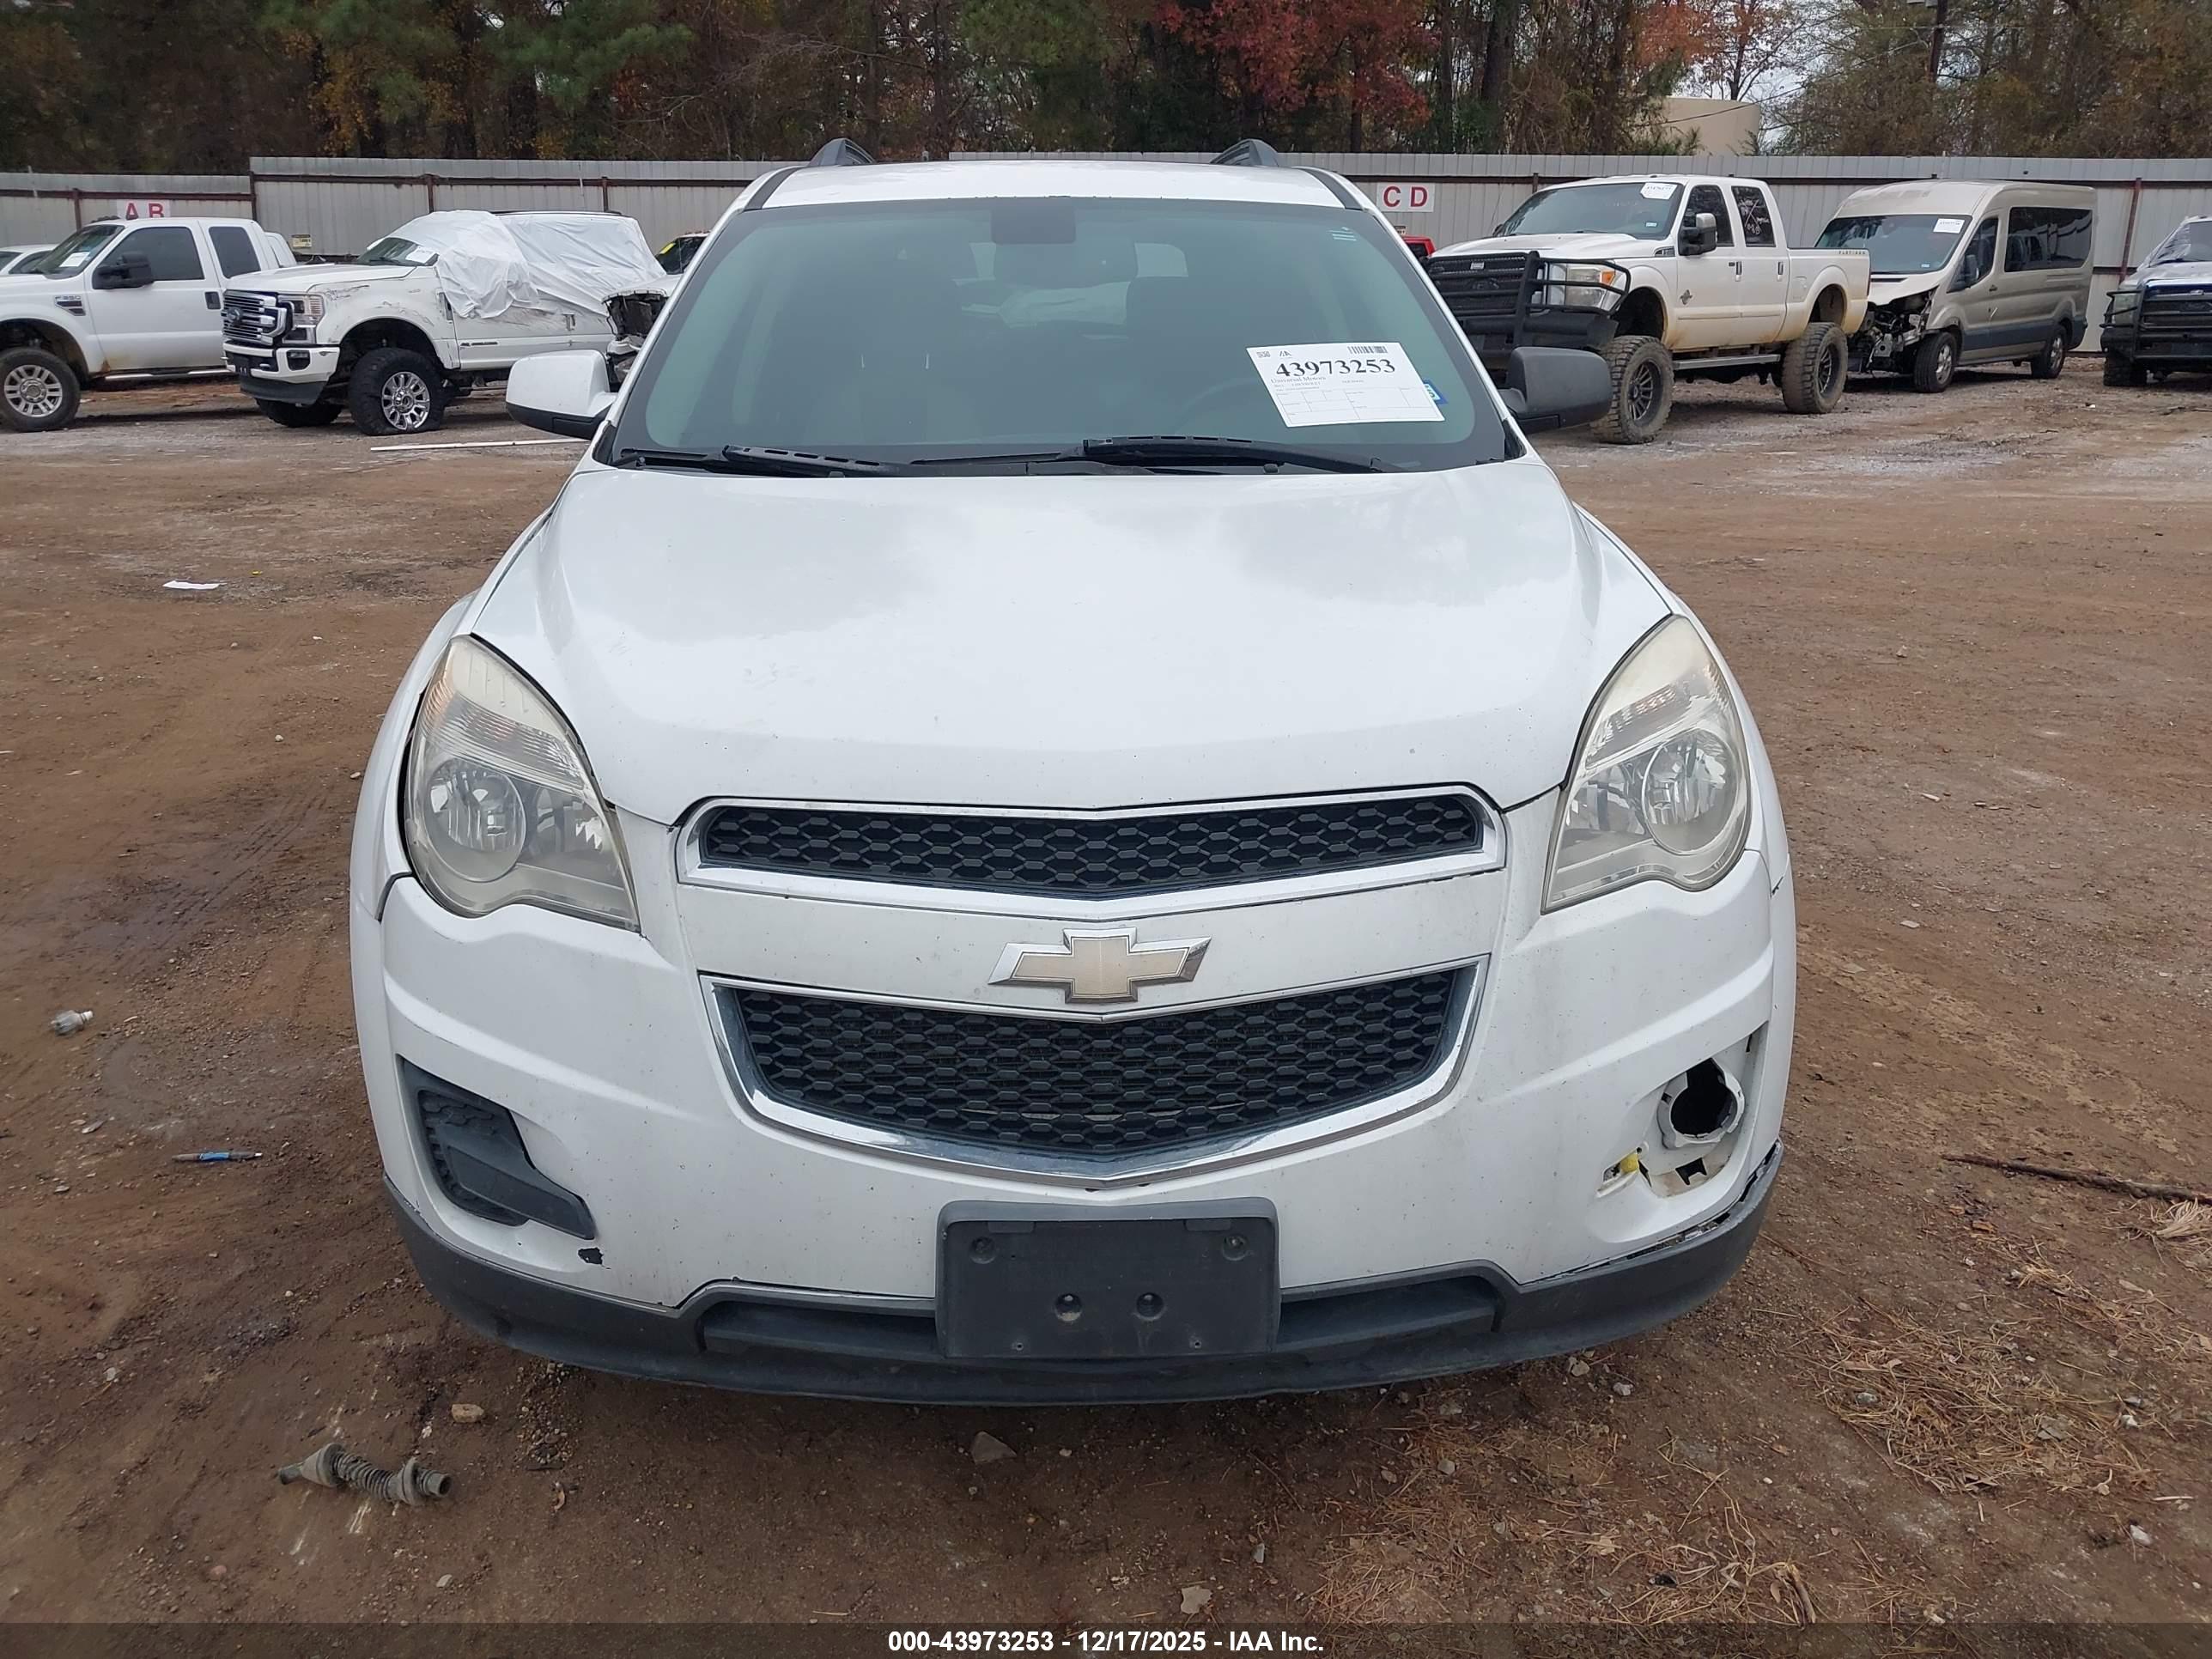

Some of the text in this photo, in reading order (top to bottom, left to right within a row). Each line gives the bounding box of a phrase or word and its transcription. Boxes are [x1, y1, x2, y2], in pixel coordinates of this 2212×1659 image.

[1383, 185, 1428, 207] C D
[125, 202, 165, 221] A B
[1276, 358, 1395, 377] 43973253
